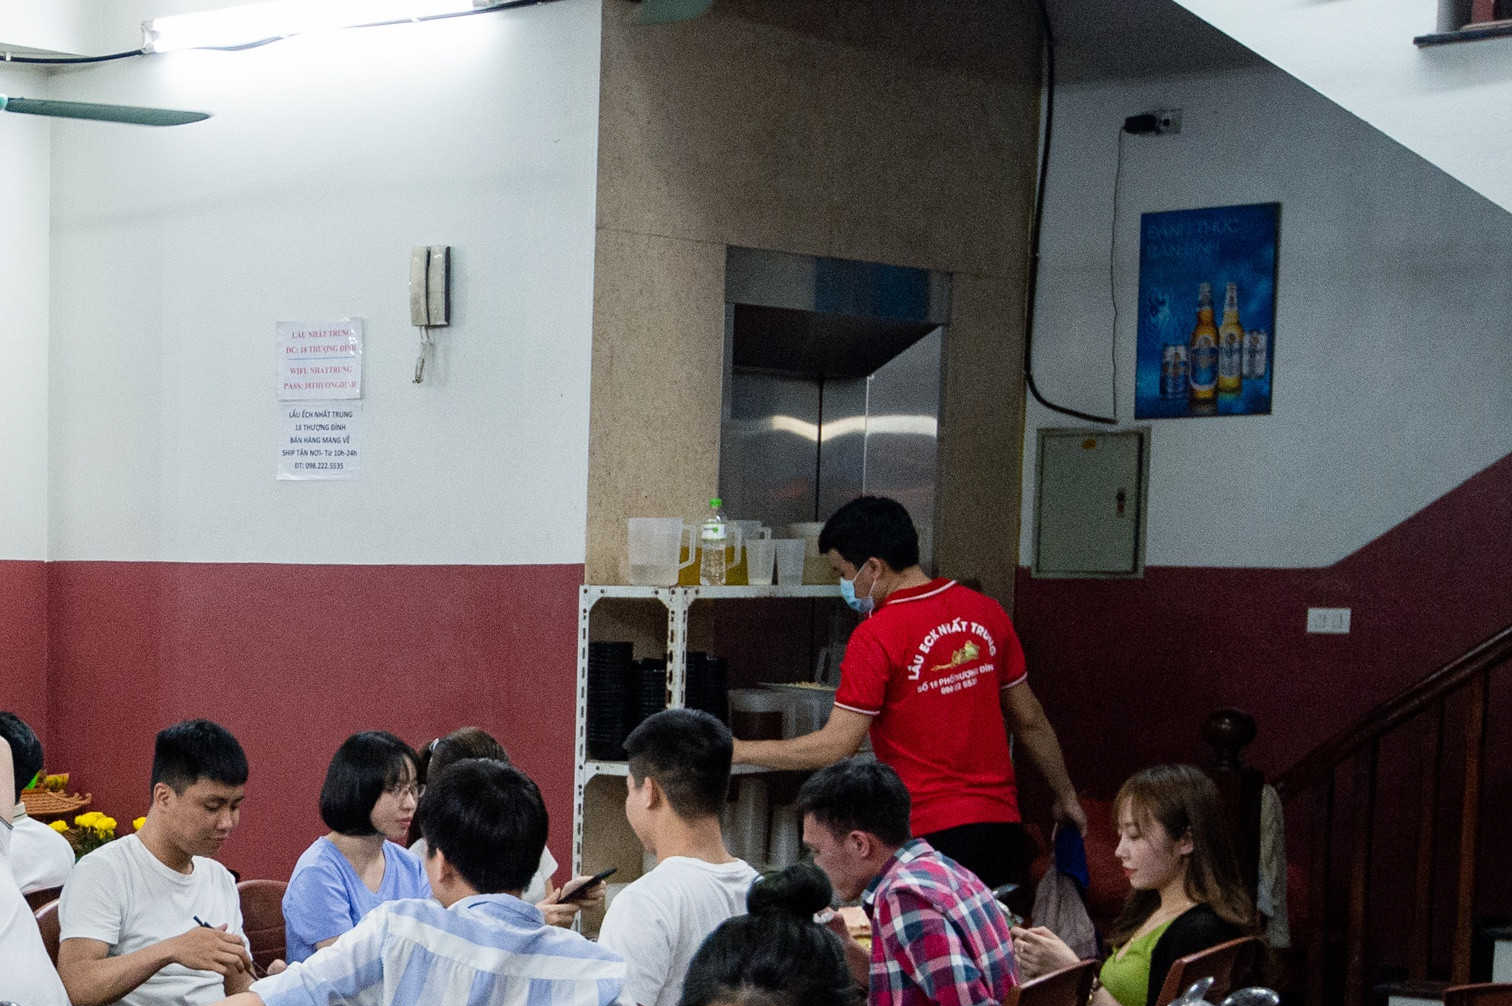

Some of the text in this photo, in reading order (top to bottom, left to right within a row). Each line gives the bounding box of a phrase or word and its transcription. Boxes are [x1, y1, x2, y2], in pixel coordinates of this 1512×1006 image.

[314, 410, 330, 418] NHẤT
[331, 423, 346, 431] ĐÌNH
[303, 435, 321, 444] HÀNG
